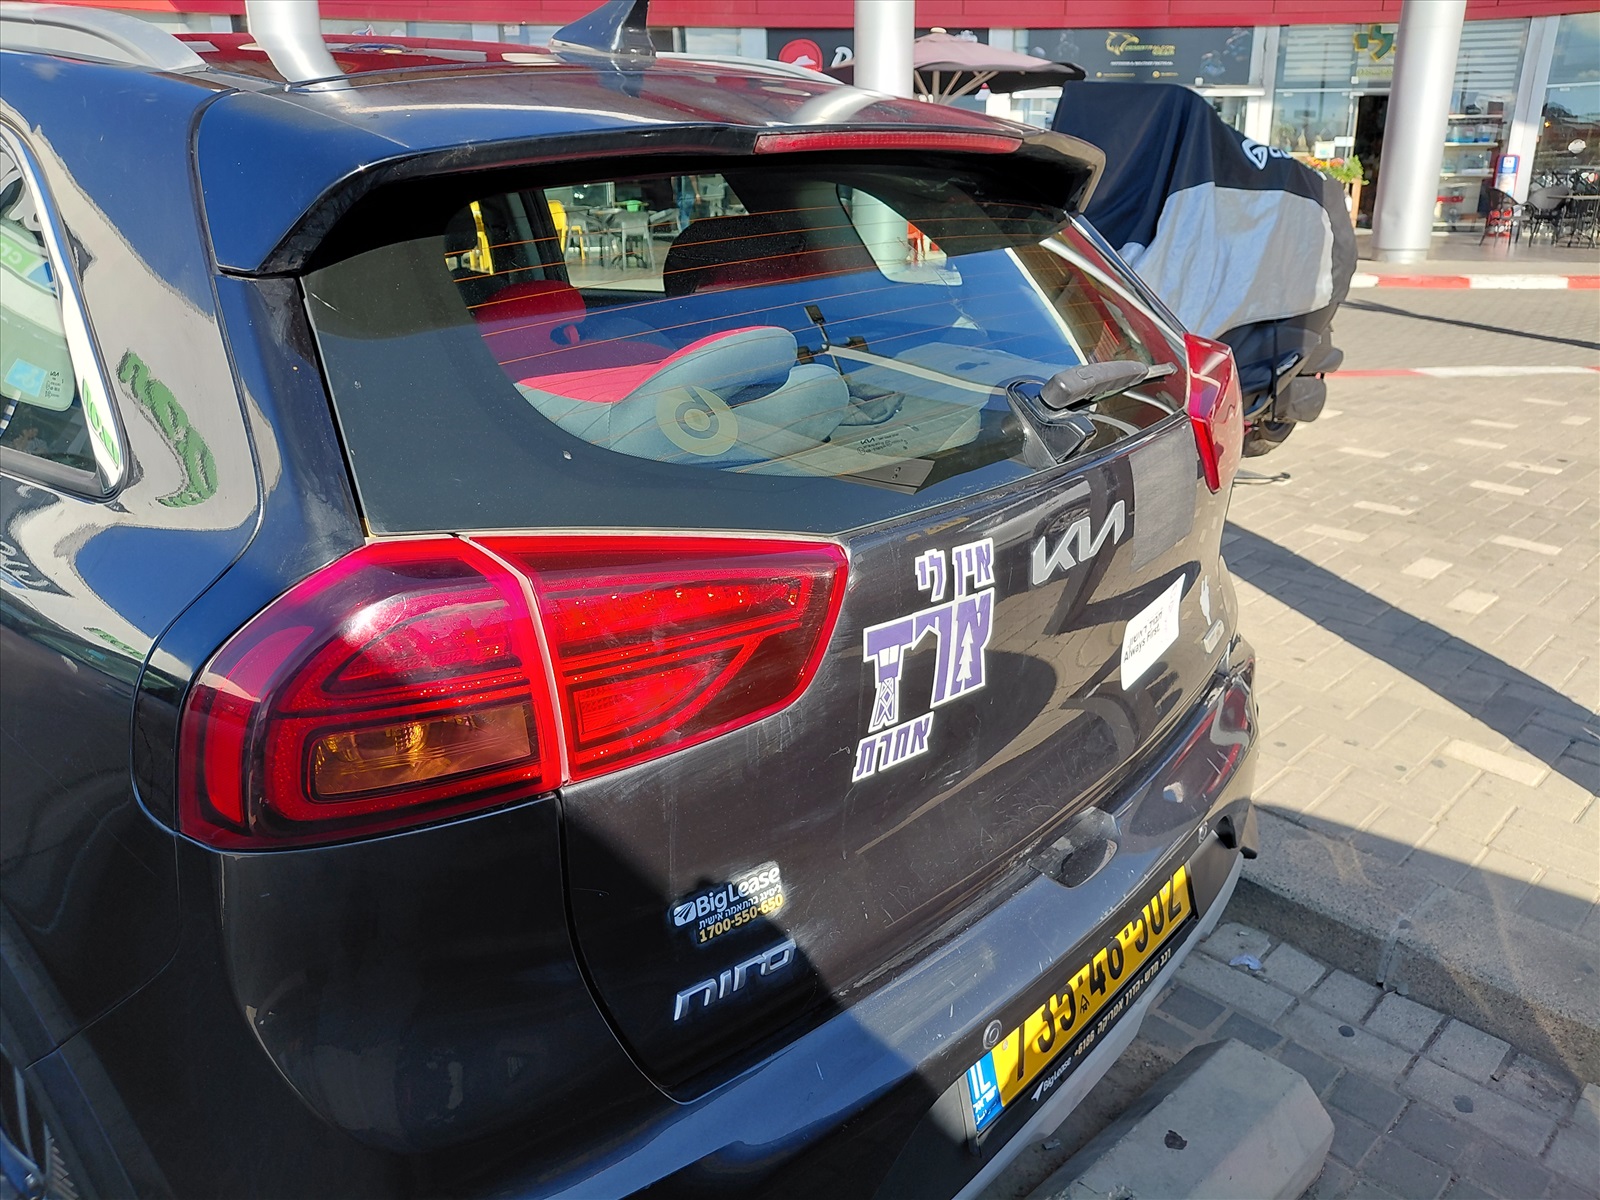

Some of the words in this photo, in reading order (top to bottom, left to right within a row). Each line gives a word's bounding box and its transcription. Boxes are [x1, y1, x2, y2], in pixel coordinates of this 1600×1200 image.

[953, 539, 993, 599] אין
[1032, 499, 1125, 585] KIA
[915, 550, 946, 602] לי
[853, 714, 933, 780] אחרת
[699, 893, 784, 943] 1700-550-650
